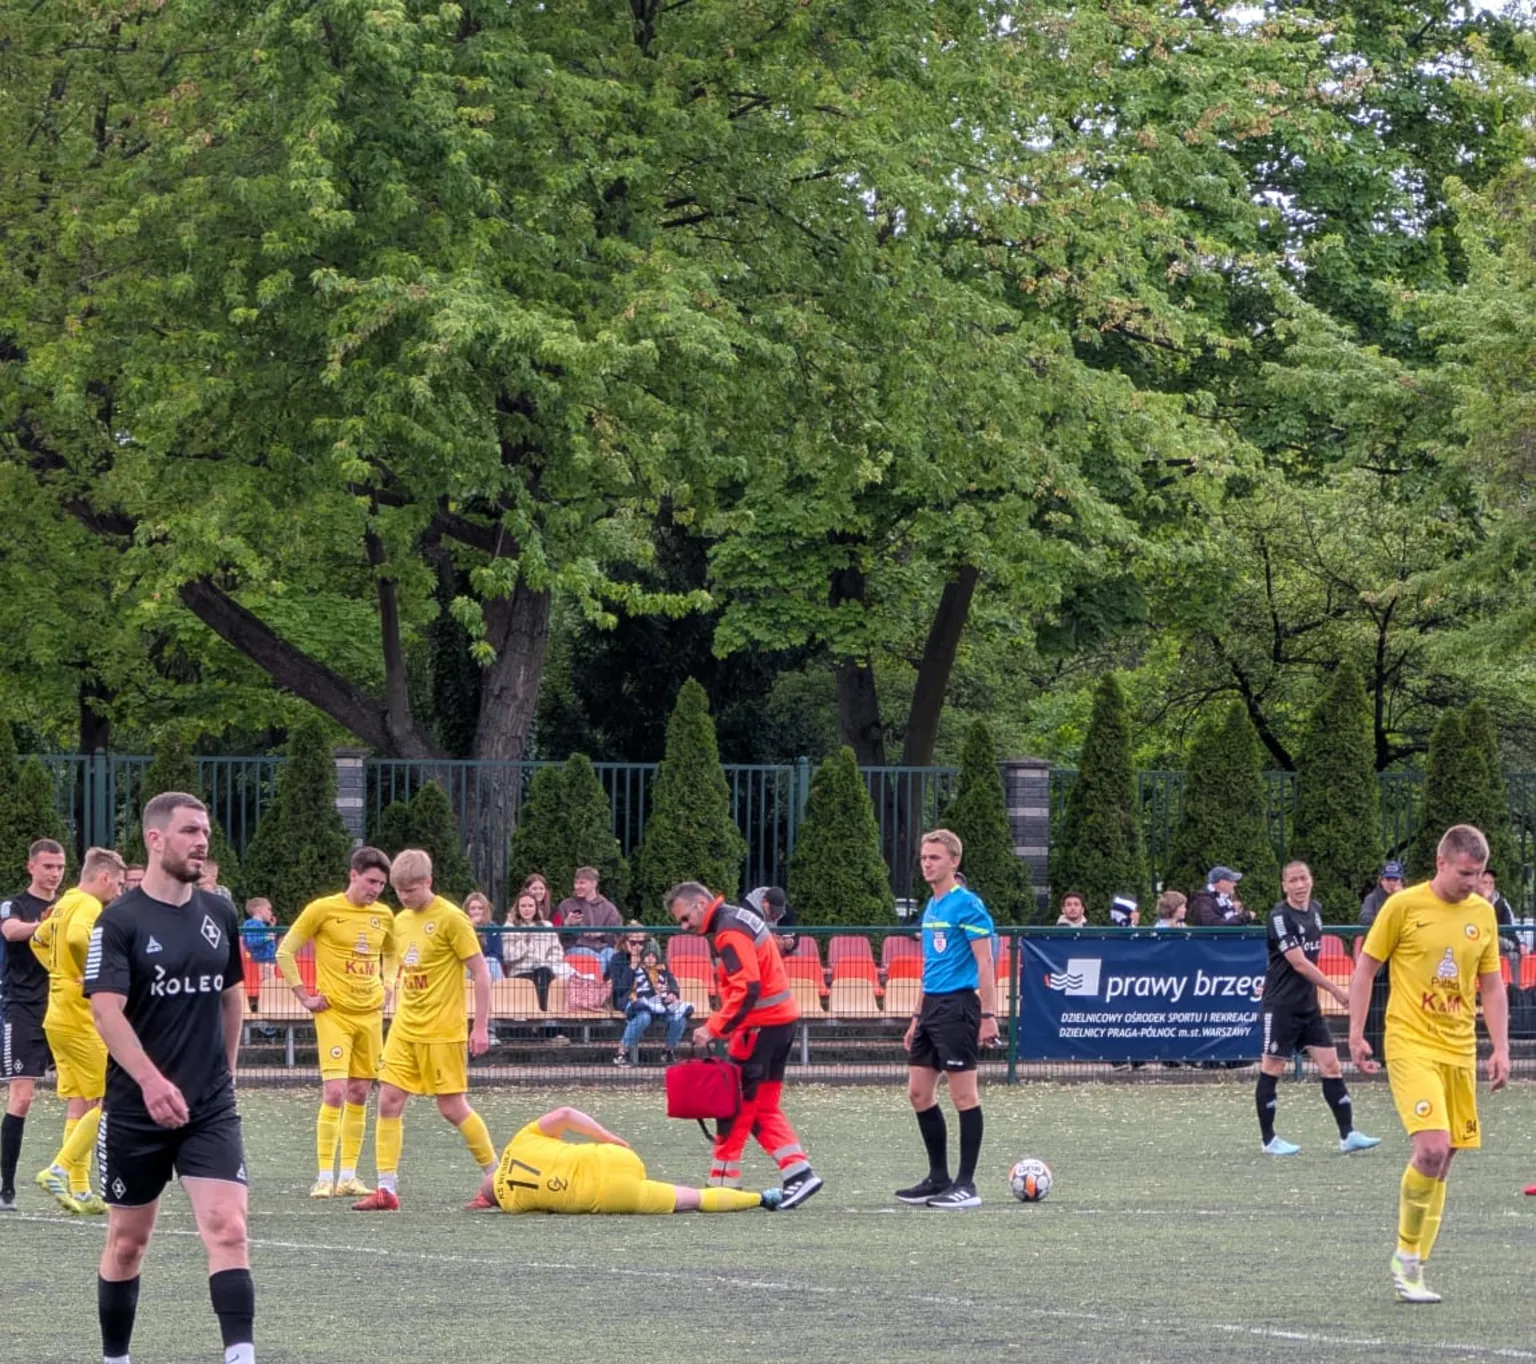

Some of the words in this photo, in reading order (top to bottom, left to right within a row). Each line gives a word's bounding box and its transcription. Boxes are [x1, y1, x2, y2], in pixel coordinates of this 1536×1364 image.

[151, 964, 224, 996] KOLEO
[1106, 974, 1187, 1003] prawy
[1193, 969, 1265, 1002] brzeg
[1059, 1027, 1105, 1038] DZIELNICY
[1061, 1012, 1123, 1023] DZIELNICOWY
[1124, 1011, 1165, 1023] OŚRODEK
[1167, 1012, 1202, 1023] SPORTU
[1209, 1012, 1258, 1023] REKREACJI
[506, 1158, 541, 1191] 17
